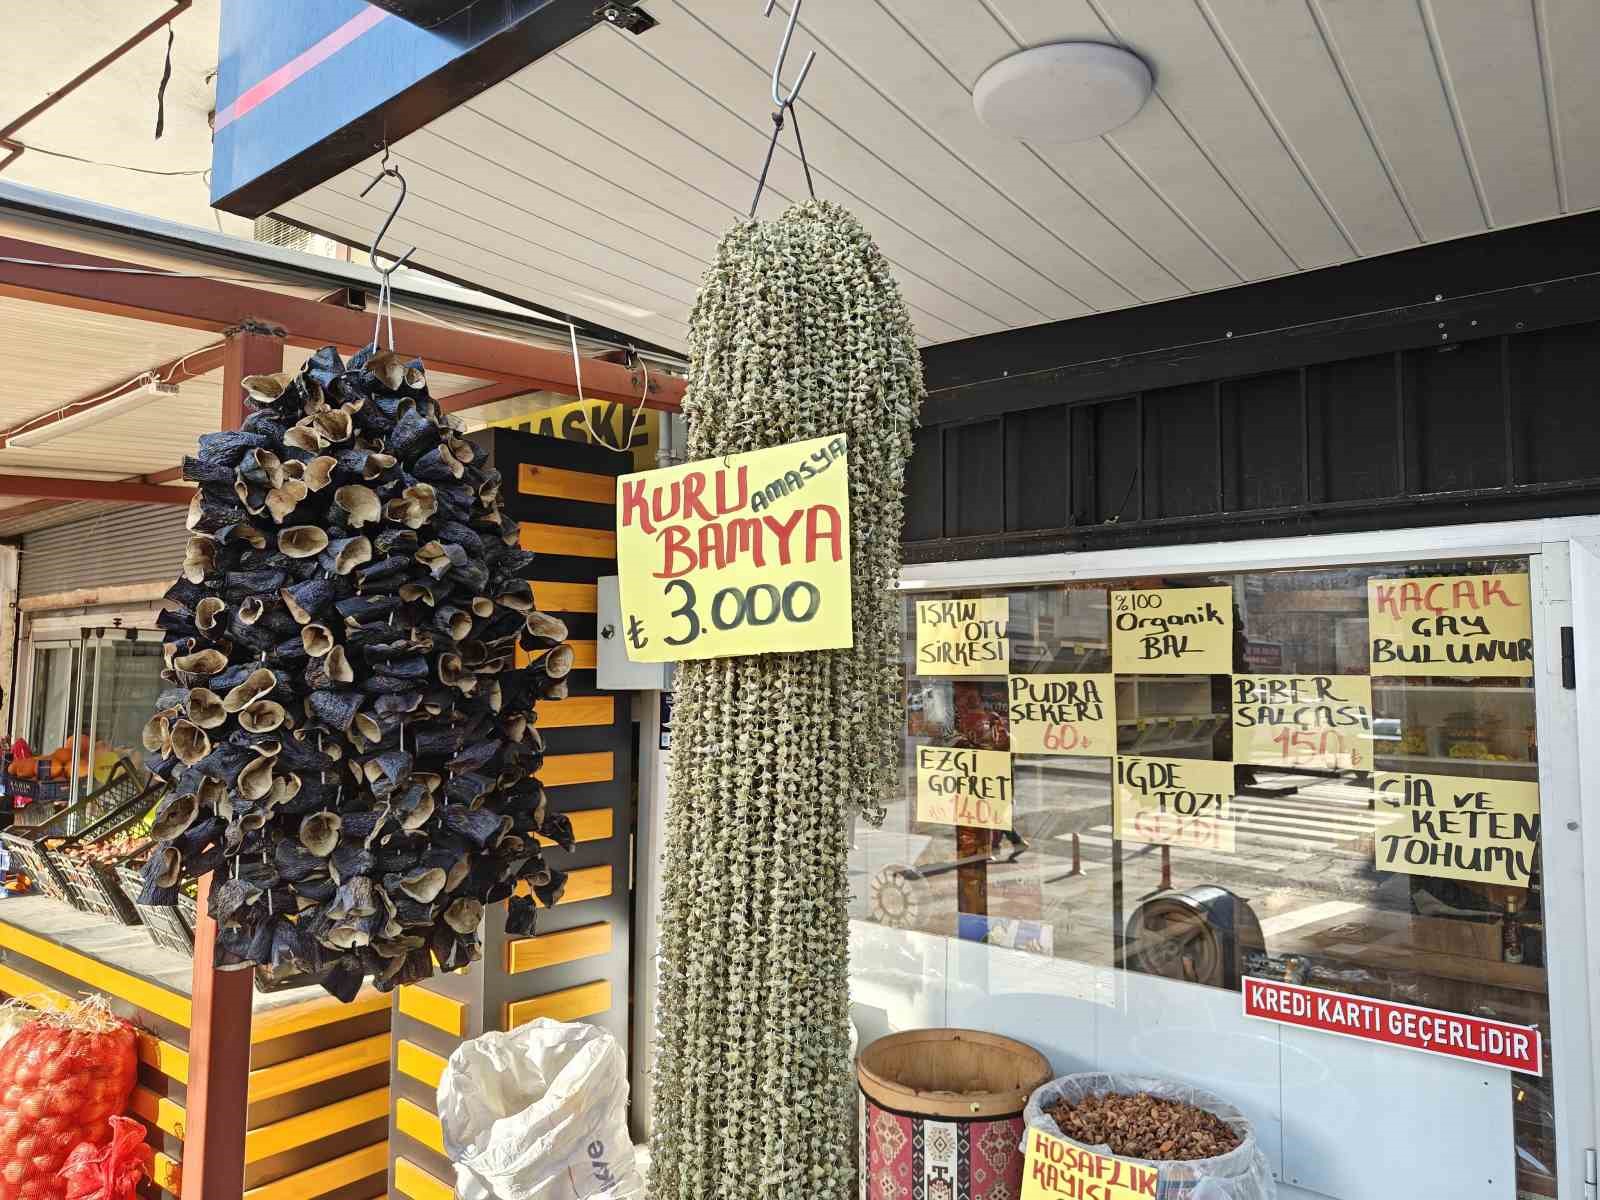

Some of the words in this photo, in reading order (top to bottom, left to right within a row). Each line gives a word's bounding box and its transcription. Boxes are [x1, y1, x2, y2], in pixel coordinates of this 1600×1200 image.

[751, 437, 846, 513] AMASYA
[622, 465, 748, 535] KURU
[652, 504, 842, 578] BAMYA
[663, 579, 821, 645] 3.000
[1115, 594, 1162, 610] %100
[1376, 580, 1521, 620] KAÇAK
[965, 620, 1008, 640] OTU
[1116, 603, 1224, 636] Organik
[1137, 635, 1205, 660] BAL
[1372, 638, 1533, 663] BULUNUR
[1010, 678, 1103, 704] PUDRA
[928, 775, 1010, 800] GOFRET
[1412, 810, 1540, 842] KETEN
[1252, 985, 1311, 1018] KREDİ
[1318, 997, 1380, 1031] KARTI
[1388, 1010, 1529, 1060] GEÇERLİDİR
[1036, 1134, 1157, 1197] HOŞAFLIK
